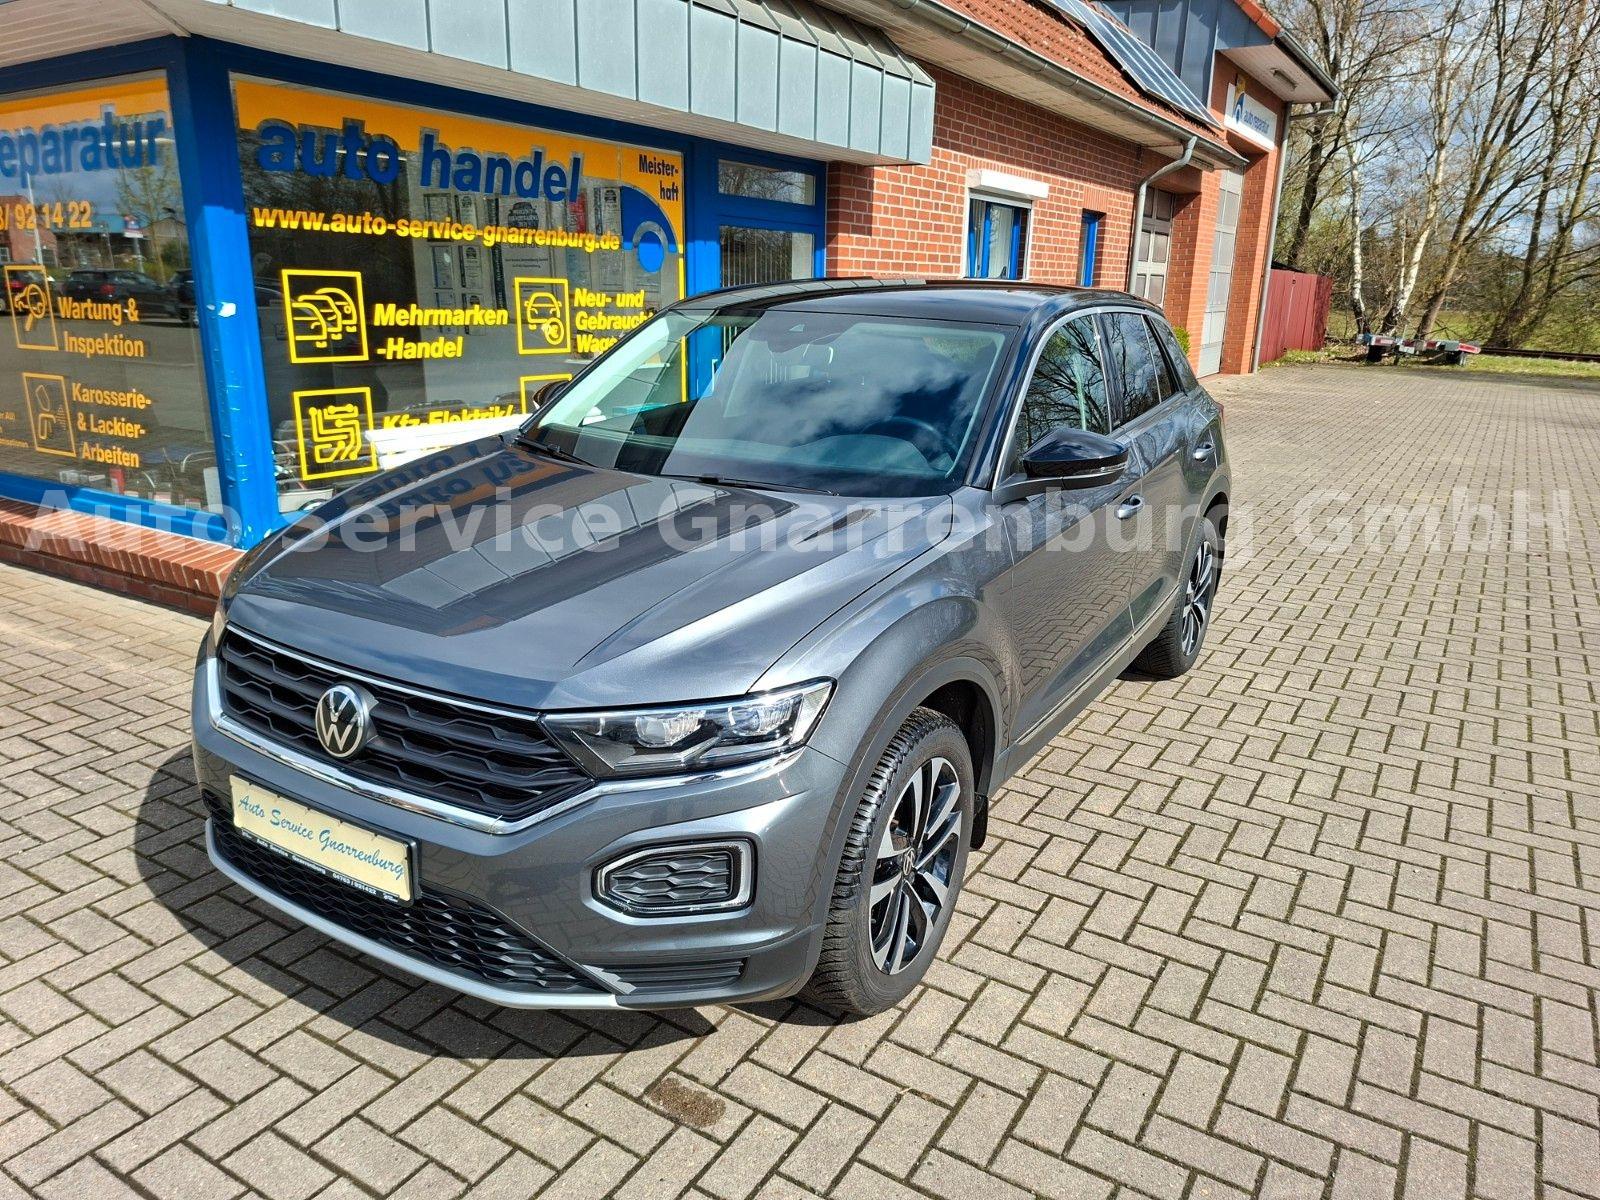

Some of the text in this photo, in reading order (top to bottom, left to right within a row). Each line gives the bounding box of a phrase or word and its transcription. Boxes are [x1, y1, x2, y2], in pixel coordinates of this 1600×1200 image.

[0, 111, 166, 189] eparatur
[257, 121, 581, 203] auto handel
[638, 153, 679, 202] Meister- haft
[15, 203, 37, 231] 92
[42, 202, 64, 229] 14
[68, 200, 92, 229] 22
[253, 206, 620, 253] www.auto-service-gnarrenburg.de
[58, 296, 140, 326] Wartung &
[574, 287, 645, 308] Neu- und
[373, 303, 509, 327] Mehrmarken
[575, 310, 654, 331] Gebrauch
[63, 330, 145, 358] Inspektion
[376, 335, 464, 360] -Handel
[72, 382, 152, 409] Karosserie-
[77, 411, 147, 438] & Lackier-
[82, 441, 140, 468] Arbeiten
[238, 794, 405, 881] Auto Service Gnarrenburg
